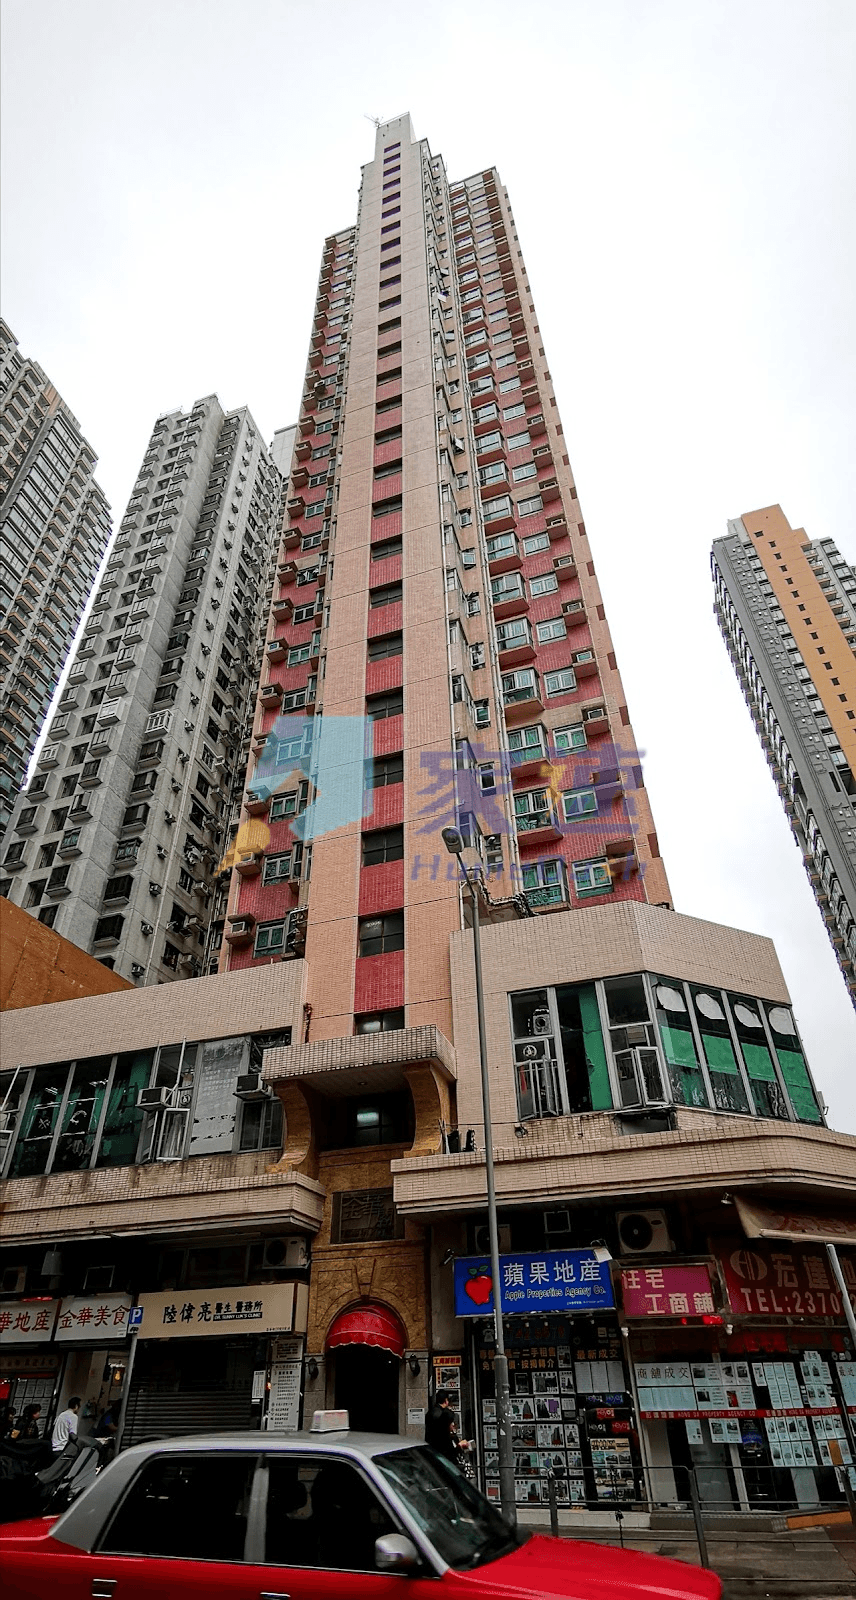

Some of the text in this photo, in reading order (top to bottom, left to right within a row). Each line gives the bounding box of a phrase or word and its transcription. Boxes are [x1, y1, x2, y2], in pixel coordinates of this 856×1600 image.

[621, 1268, 665, 1290] 住宅
[505, 1290, 525, 1301] Apple
[527, 1287, 563, 1299] Properties
[565, 1285, 591, 1298] Agency
[59, 1304, 130, 1330] 金華美食
[131, 1308, 141, 1323] P
[163, 1302, 212, 1324] 陸偉亮
